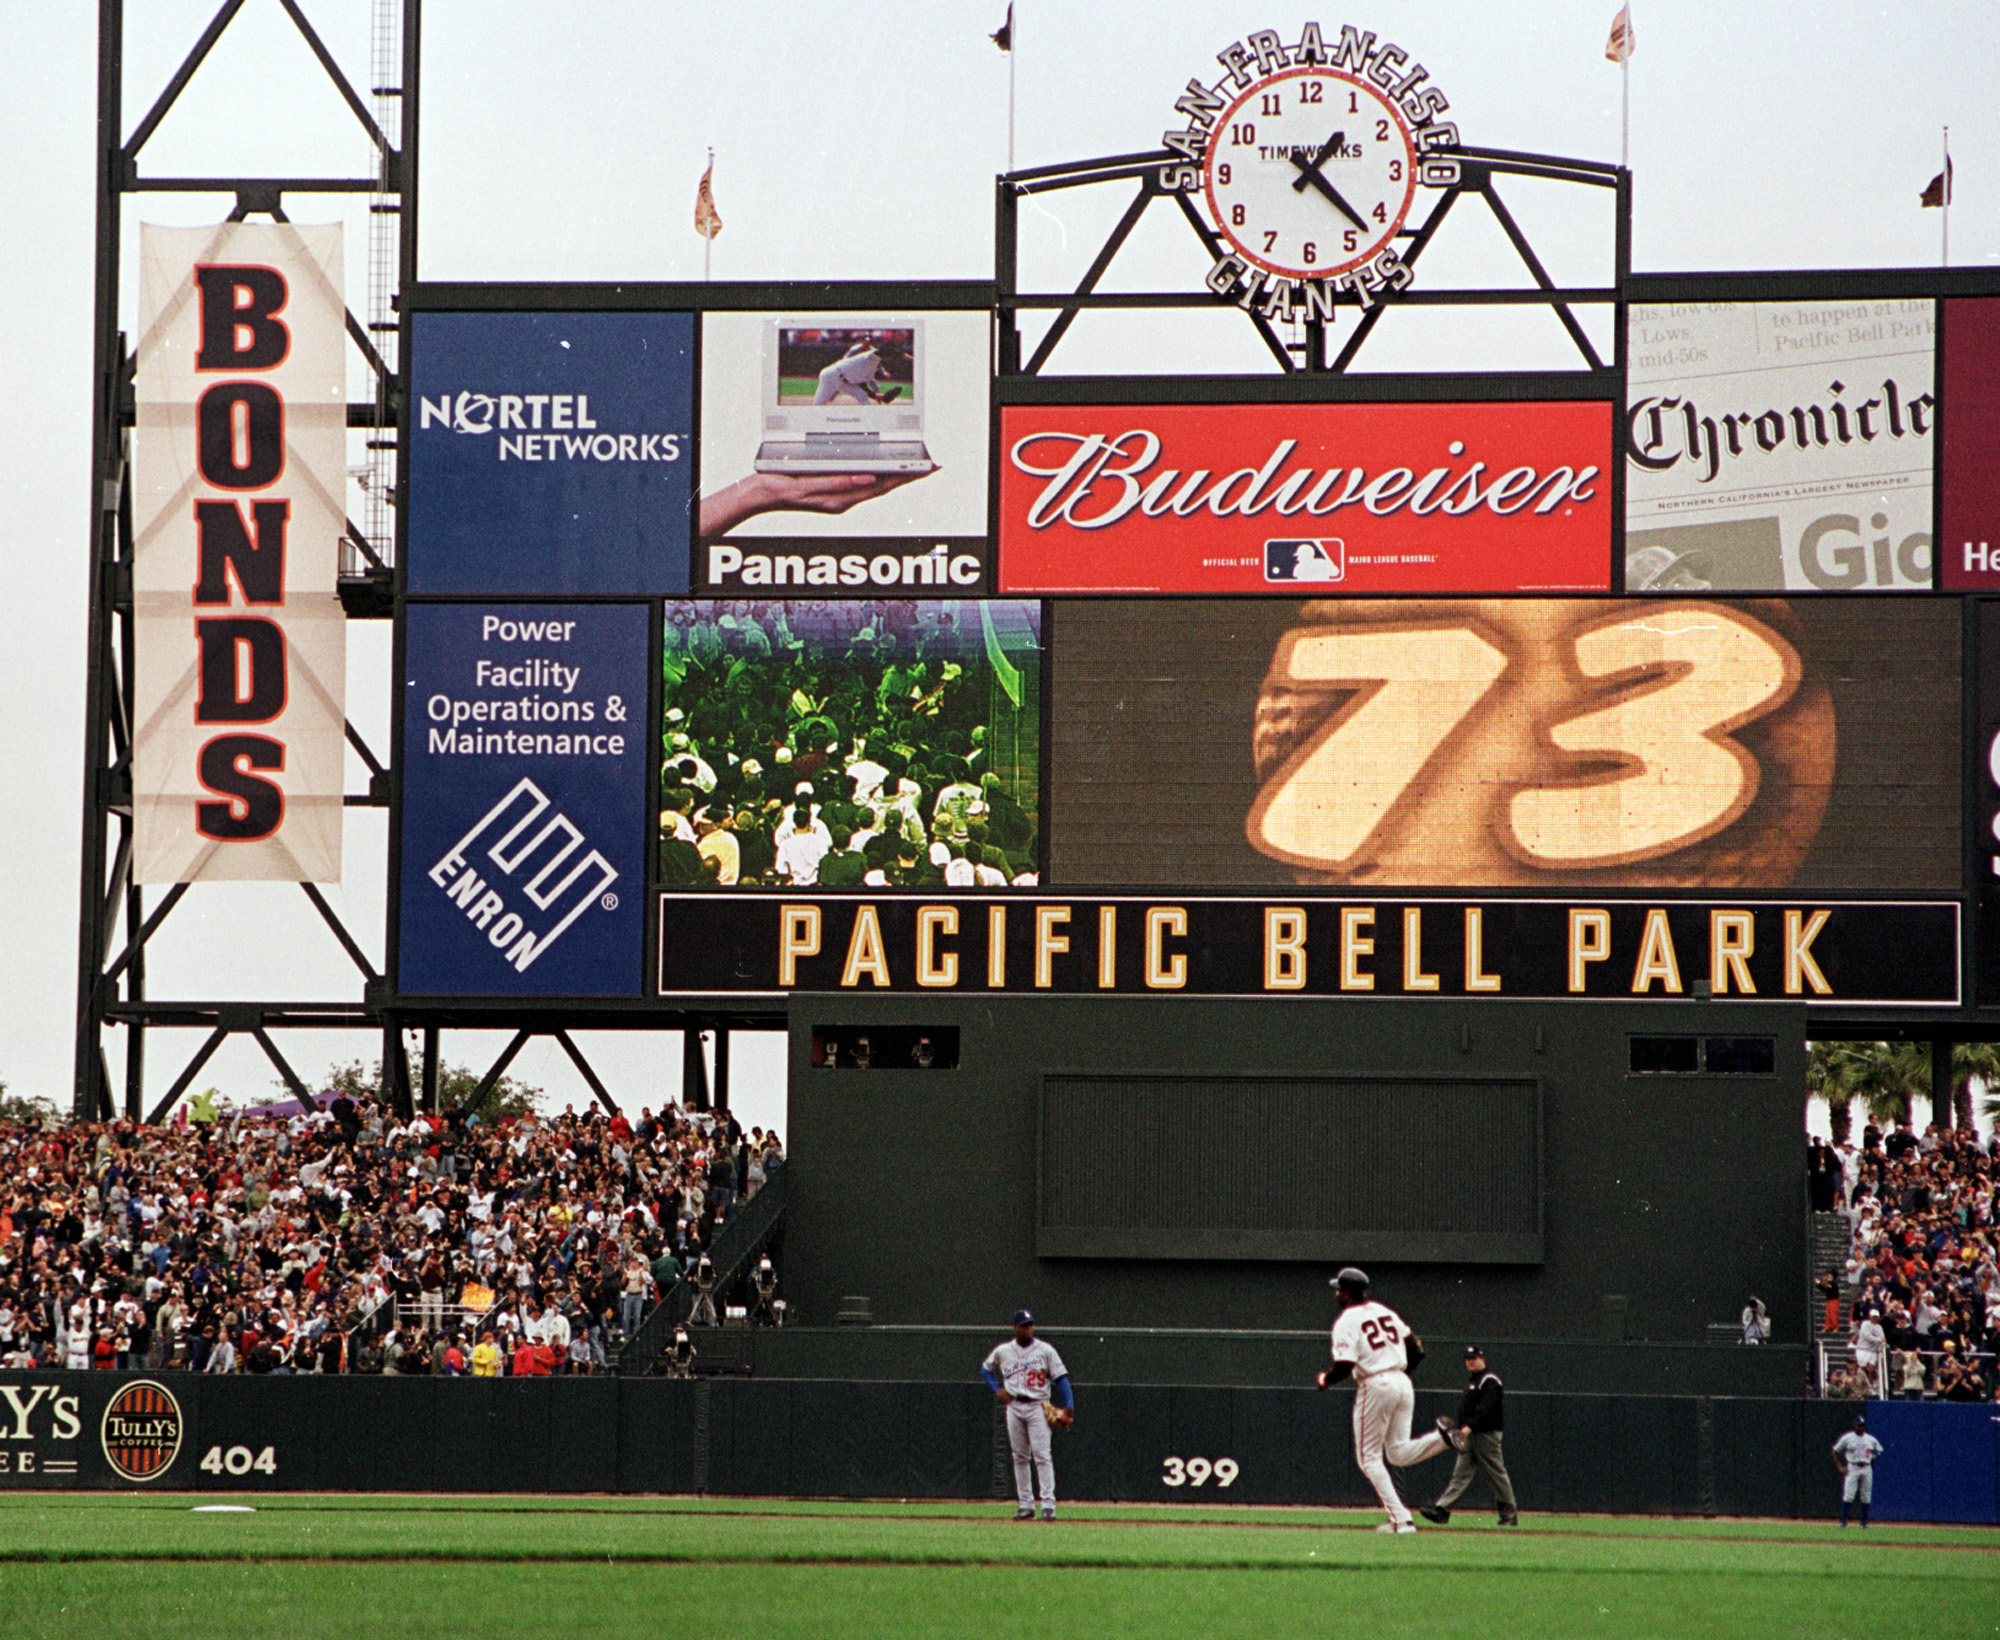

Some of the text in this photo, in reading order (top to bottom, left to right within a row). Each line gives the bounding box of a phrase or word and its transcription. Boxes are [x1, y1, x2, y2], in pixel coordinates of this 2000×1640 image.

[1261, 94, 1281, 116] 11
[1299, 82, 1323, 104] 12
[1348, 92, 1358, 113] 1
[1159, 22, 1461, 193] SAN FRANCISCO
[1231, 124, 1255, 146] 10
[1375, 120, 1389, 142] 2
[1218, 164, 1231, 185] 9
[1389, 160, 1402, 182] 3
[1232, 204, 1245, 226] 8
[1372, 202, 1387, 223] 4
[1263, 231, 1278, 253] 7
[1303, 243, 1316, 264] 6
[1343, 230, 1357, 252] 5
[1206, 248, 1415, 324] GIANTS
[1772, 313, 1791, 328] to
[1797, 305, 1868, 327] happen
[1874, 301, 1892, 316] at
[1775, 330, 1840, 352] Pacific
[1848, 324, 1884, 344] Bell
[420, 390, 596, 434] NORTEL
[1627, 378, 1935, 483] Chronicle
[1011, 429, 1599, 531] Budweiser
[193, 263, 291, 842] BONDS
[708, 543, 981, 587] Panasonic
[1203, 557, 1260, 567] OFFICIAL BEER
[1348, 556, 1372, 564] MAJOR
[1374, 555, 1399, 564] LEAGUE
[483, 615, 576, 642] Power
[475, 659, 580, 693] Facility
[427, 694, 627, 728] Operations &
[428, 727, 625, 755] Maintenance
[1250, 603, 1800, 870] 73
[428, 852, 540, 974] ENRON
[779, 903, 1834, 995] PACIFIC BELL PARK
[1361, 1315, 1400, 1352] 25
[1026, 1370, 1046, 1388] 29
[0, 1385, 81, 1440] Y'S
[200, 1445, 277, 1475] 404
[1162, 1456, 1240, 1488] 399
